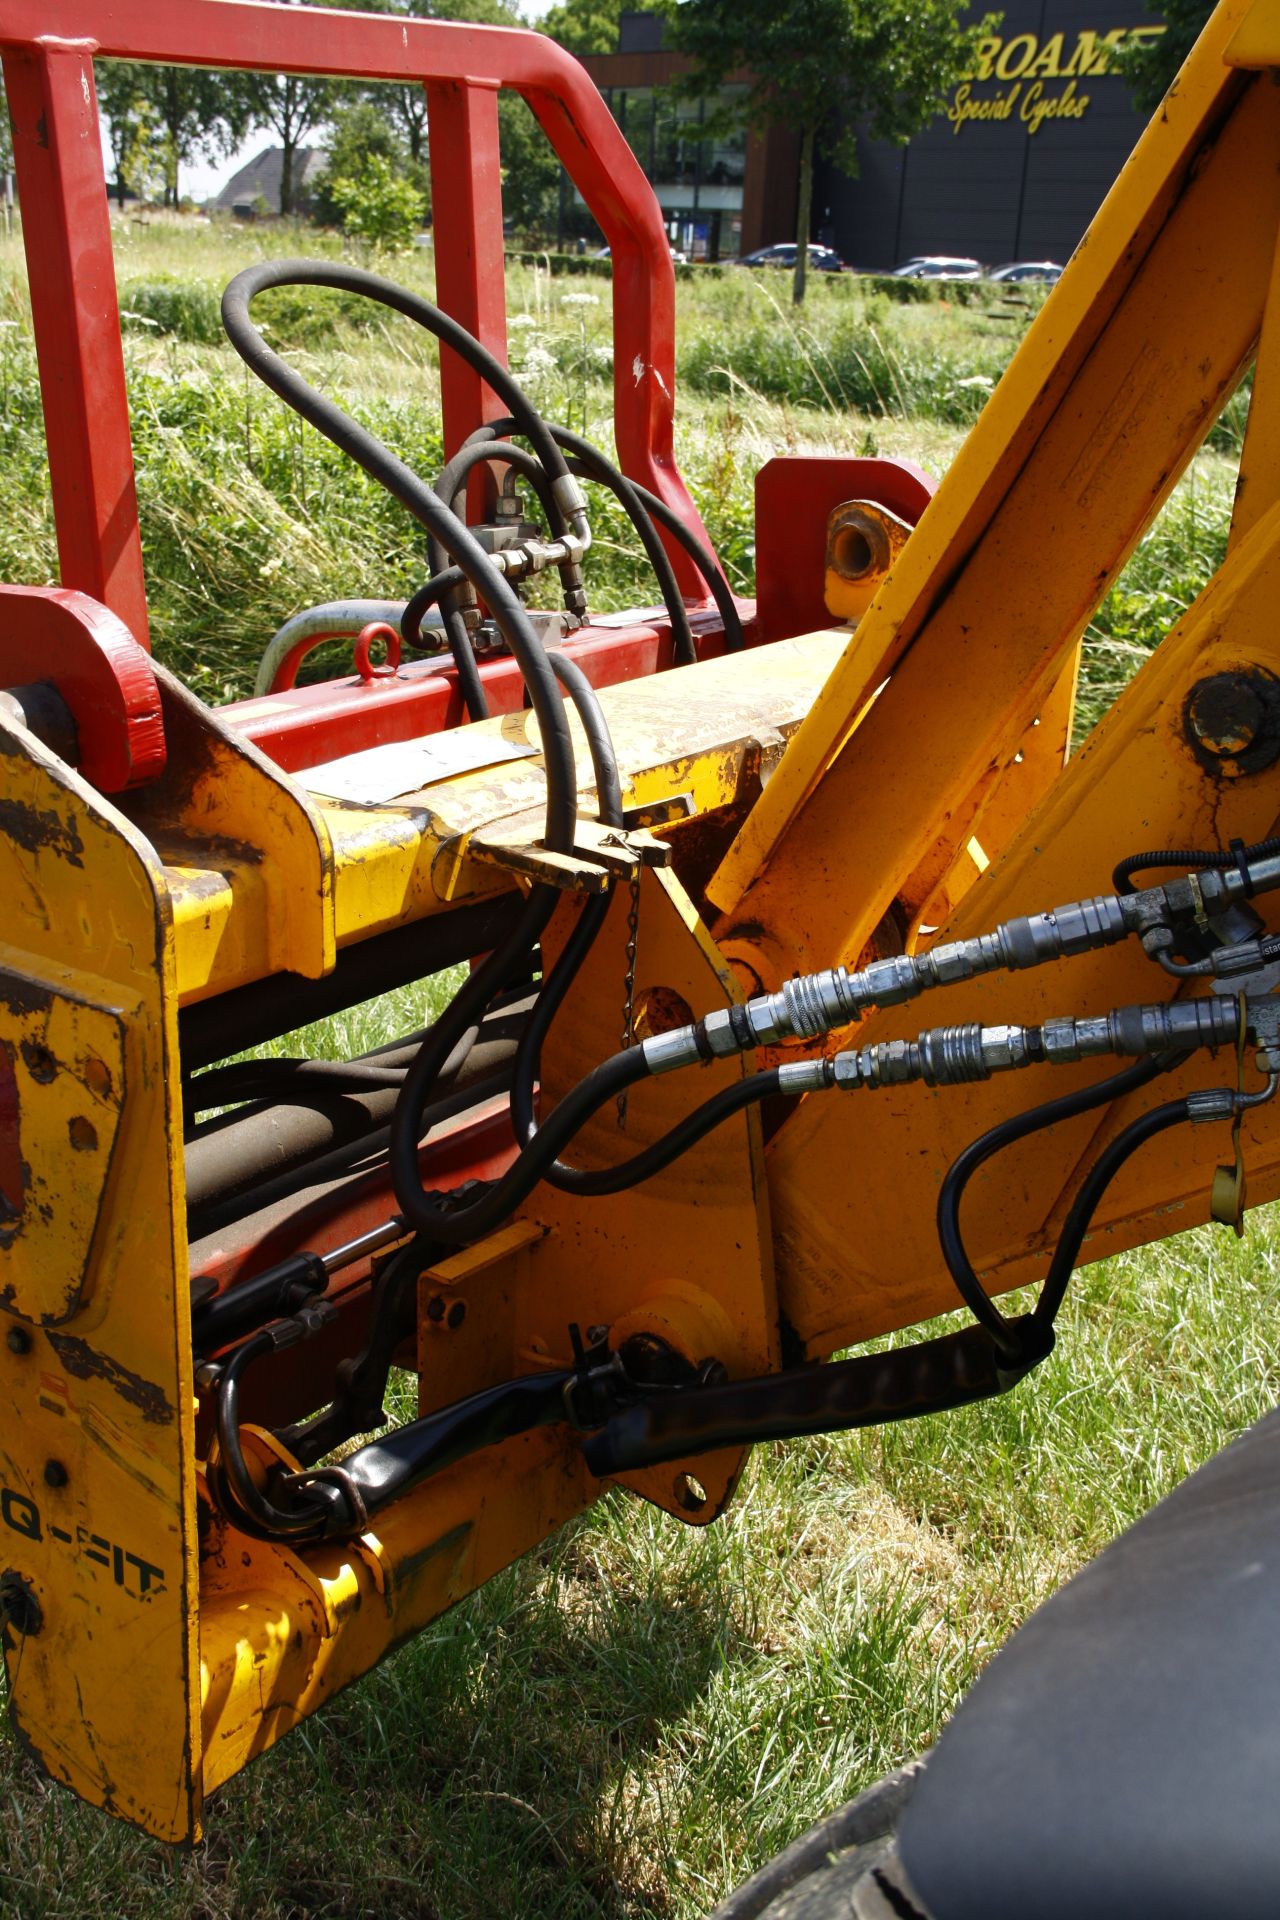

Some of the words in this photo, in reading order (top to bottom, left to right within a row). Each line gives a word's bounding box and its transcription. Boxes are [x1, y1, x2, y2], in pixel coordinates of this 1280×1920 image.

[948, 82, 1022, 134] Special
[1020, 80, 1090, 134] Cycles
[1, 1487, 165, 1593] Q-FIT
